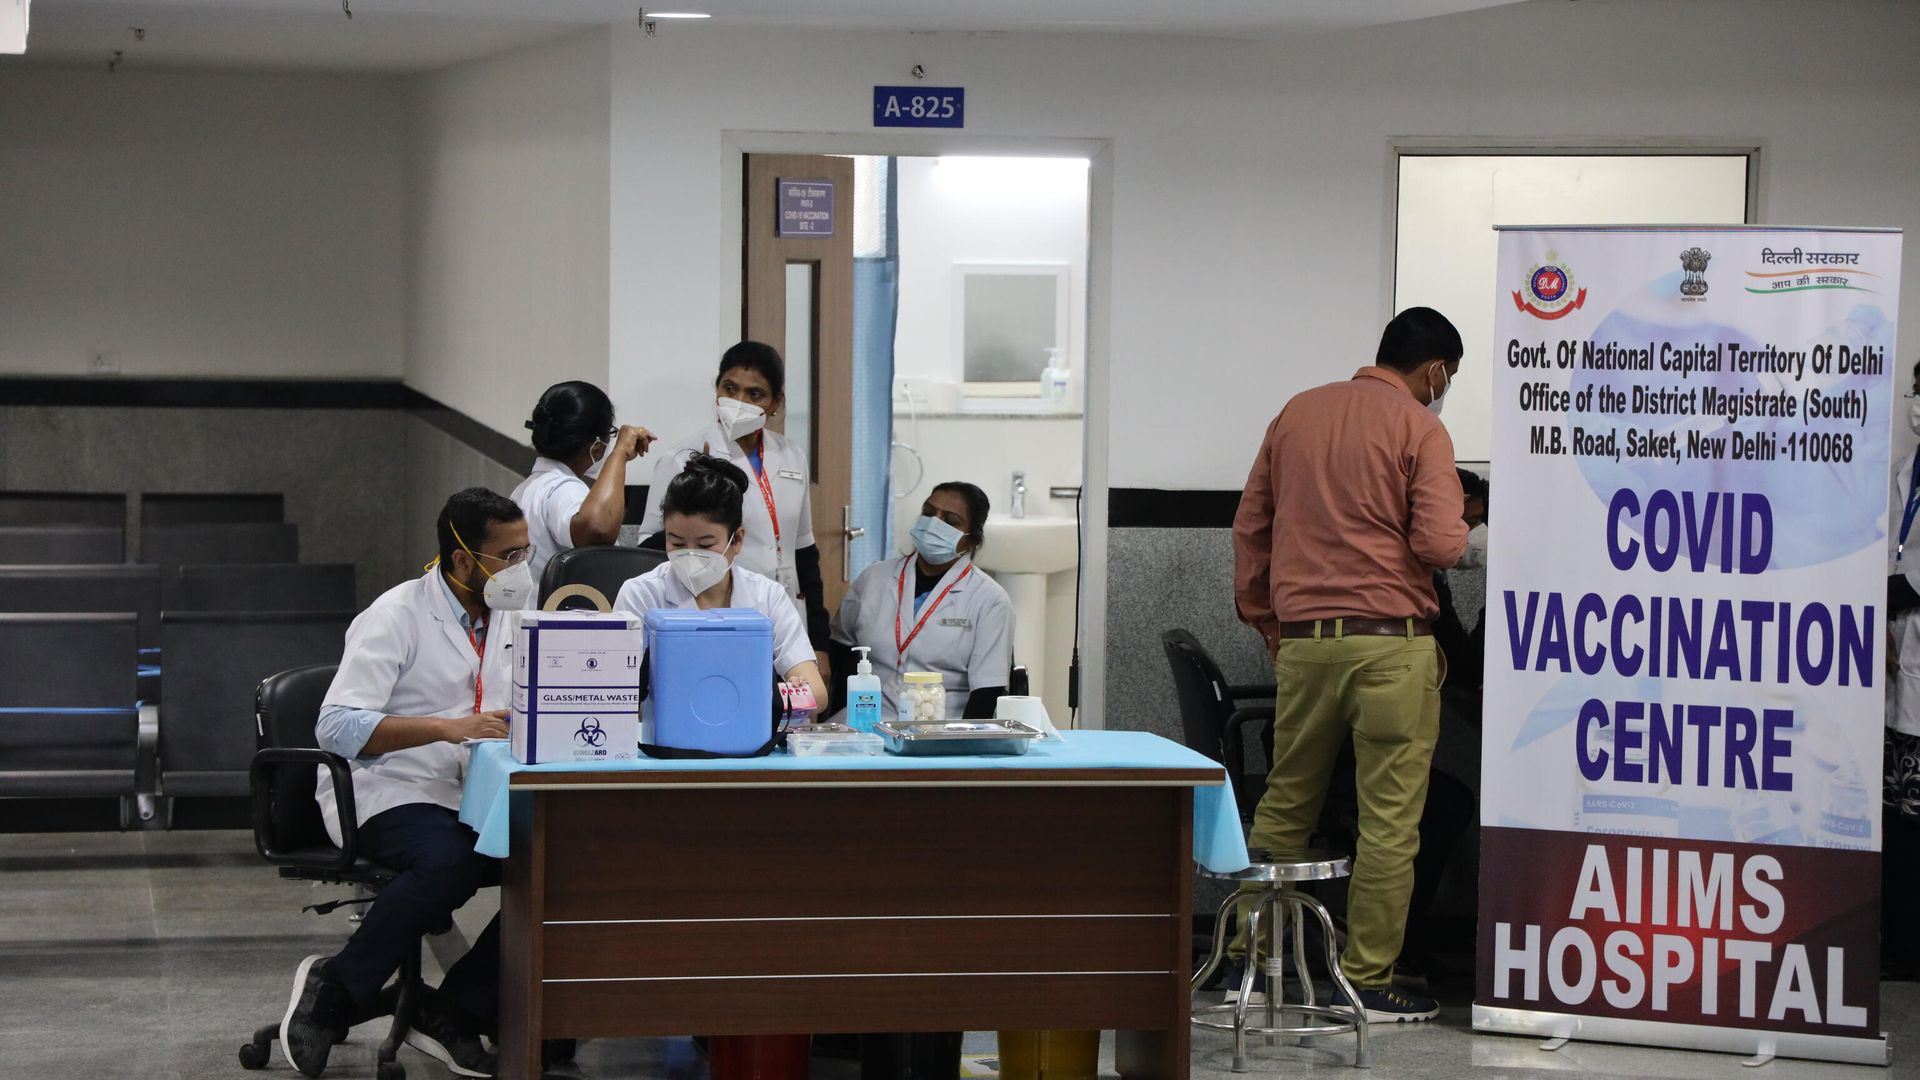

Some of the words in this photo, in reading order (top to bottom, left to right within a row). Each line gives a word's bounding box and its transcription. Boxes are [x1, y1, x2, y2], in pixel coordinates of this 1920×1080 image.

[885, 96, 953, 117] A-825
[1762, 248, 1803, 264] दिल्ली
[1806, 253, 1859, 264] सरकार
[1772, 280, 1791, 289] आप
[1796, 275, 1810, 286] की
[1816, 277, 1849, 287] सरकार
[1508, 339, 1550, 368] Govt.
[1557, 341, 1576, 369] Of
[1582, 341, 1654, 370] National
[1660, 342, 1722, 378] Capital
[1728, 343, 1806, 381] Territory
[1812, 345, 1832, 373] Of
[1839, 345, 1883, 375] Delhi
[1520, 383, 1570, 412] Office
[1576, 384, 1593, 412] of
[1599, 385, 1626, 413] the
[1632, 385, 1696, 415] District
[1703, 387, 1796, 423] Magistrate
[1804, 389, 1867, 427] (South)
[1530, 426, 1567, 454] M.B.
[1573, 427, 1620, 463] Road,
[1627, 428, 1680, 465] Saket,
[1687, 430, 1726, 459] New
[1732, 431, 1776, 460] Delhi
[1782, 432, 1852, 463] -110068
[1607, 488, 1773, 574] COVID
[1504, 591, 1874, 687] VACCINATION
[543, 694, 605, 702] GLASS/METAL
[606, 694, 639, 702] WASTE
[1576, 699, 1793, 791] CENTRE
[1569, 844, 1785, 934] AIIMS
[1494, 922, 1868, 1027] HOSPITAL
